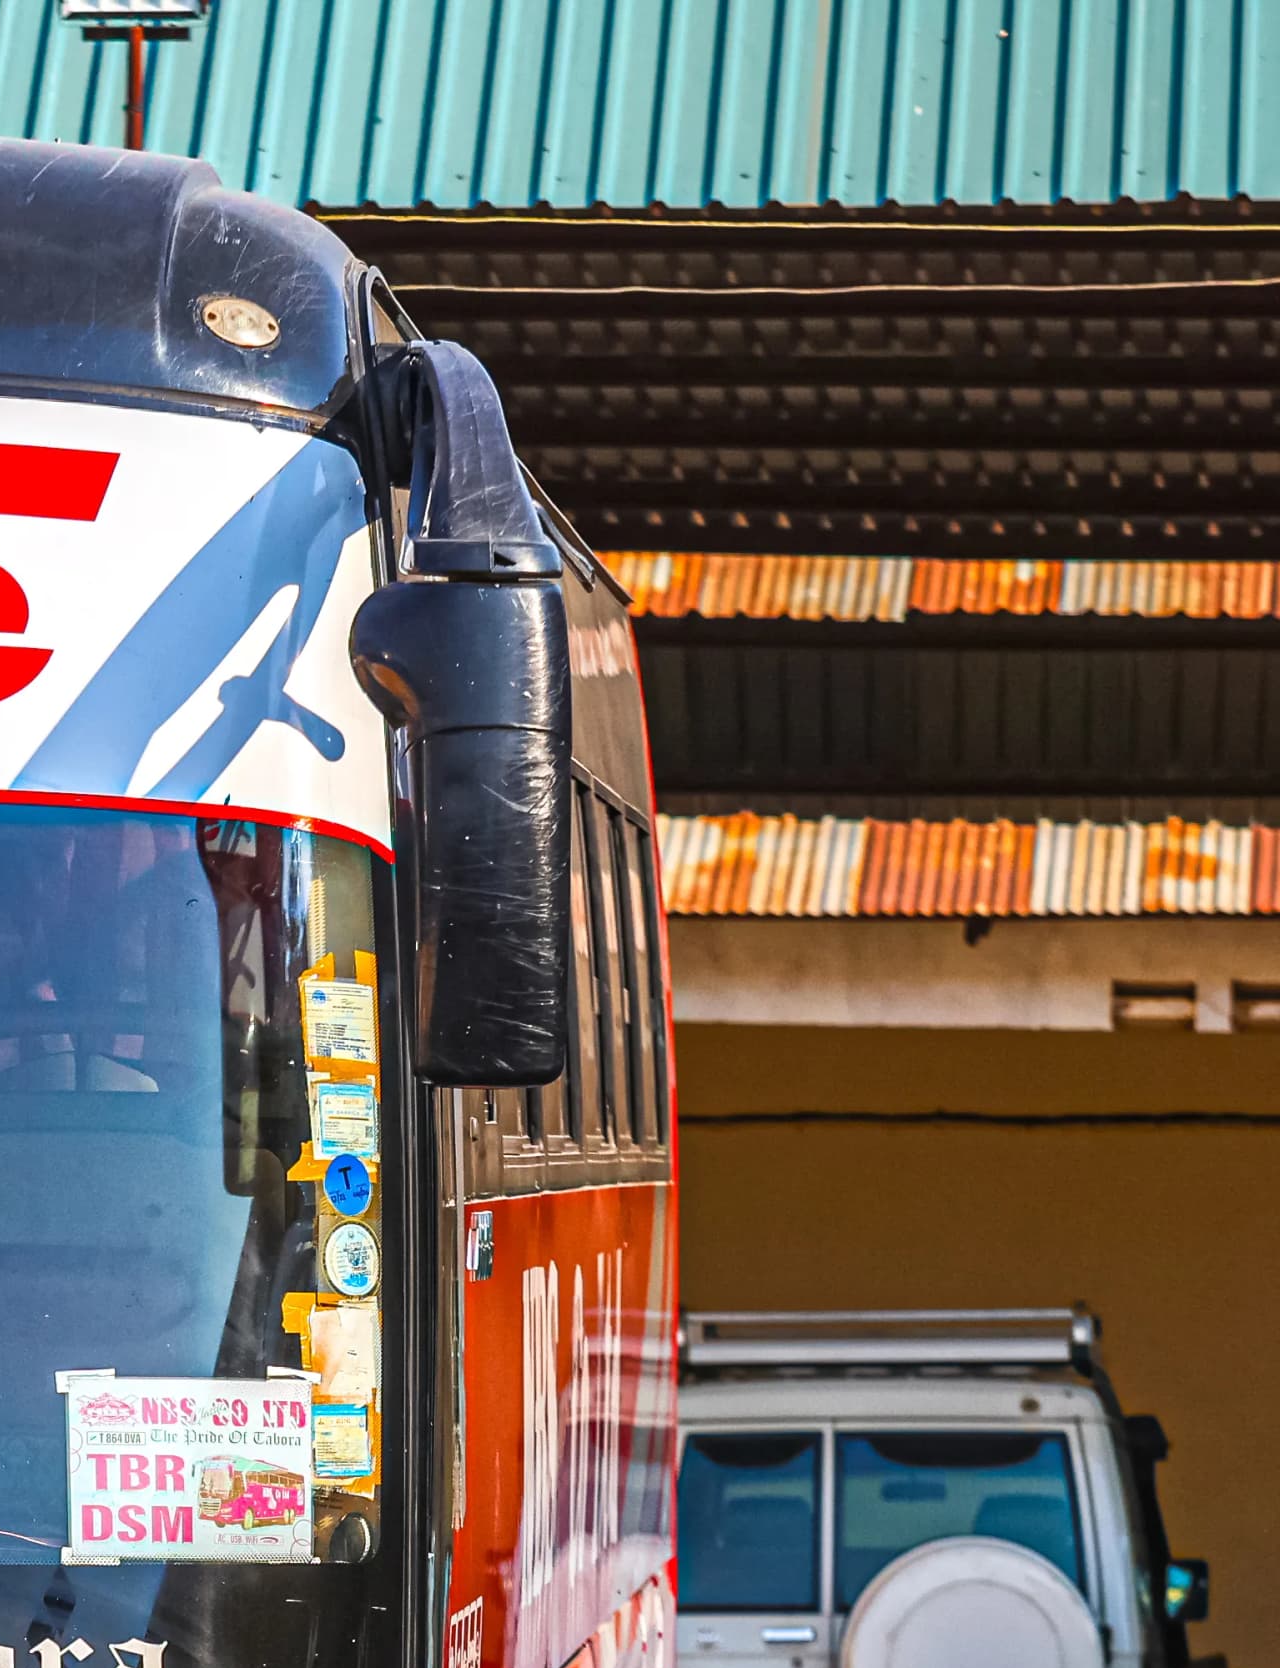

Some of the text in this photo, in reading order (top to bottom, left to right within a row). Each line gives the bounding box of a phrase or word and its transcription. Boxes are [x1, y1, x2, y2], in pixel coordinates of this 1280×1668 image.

[142, 1397, 197, 1427] NBS
[150, 1428, 302, 1446] The Pride Of Tabora
[86, 1453, 186, 1492] TBR
[81, 1504, 194, 1544] DSM
